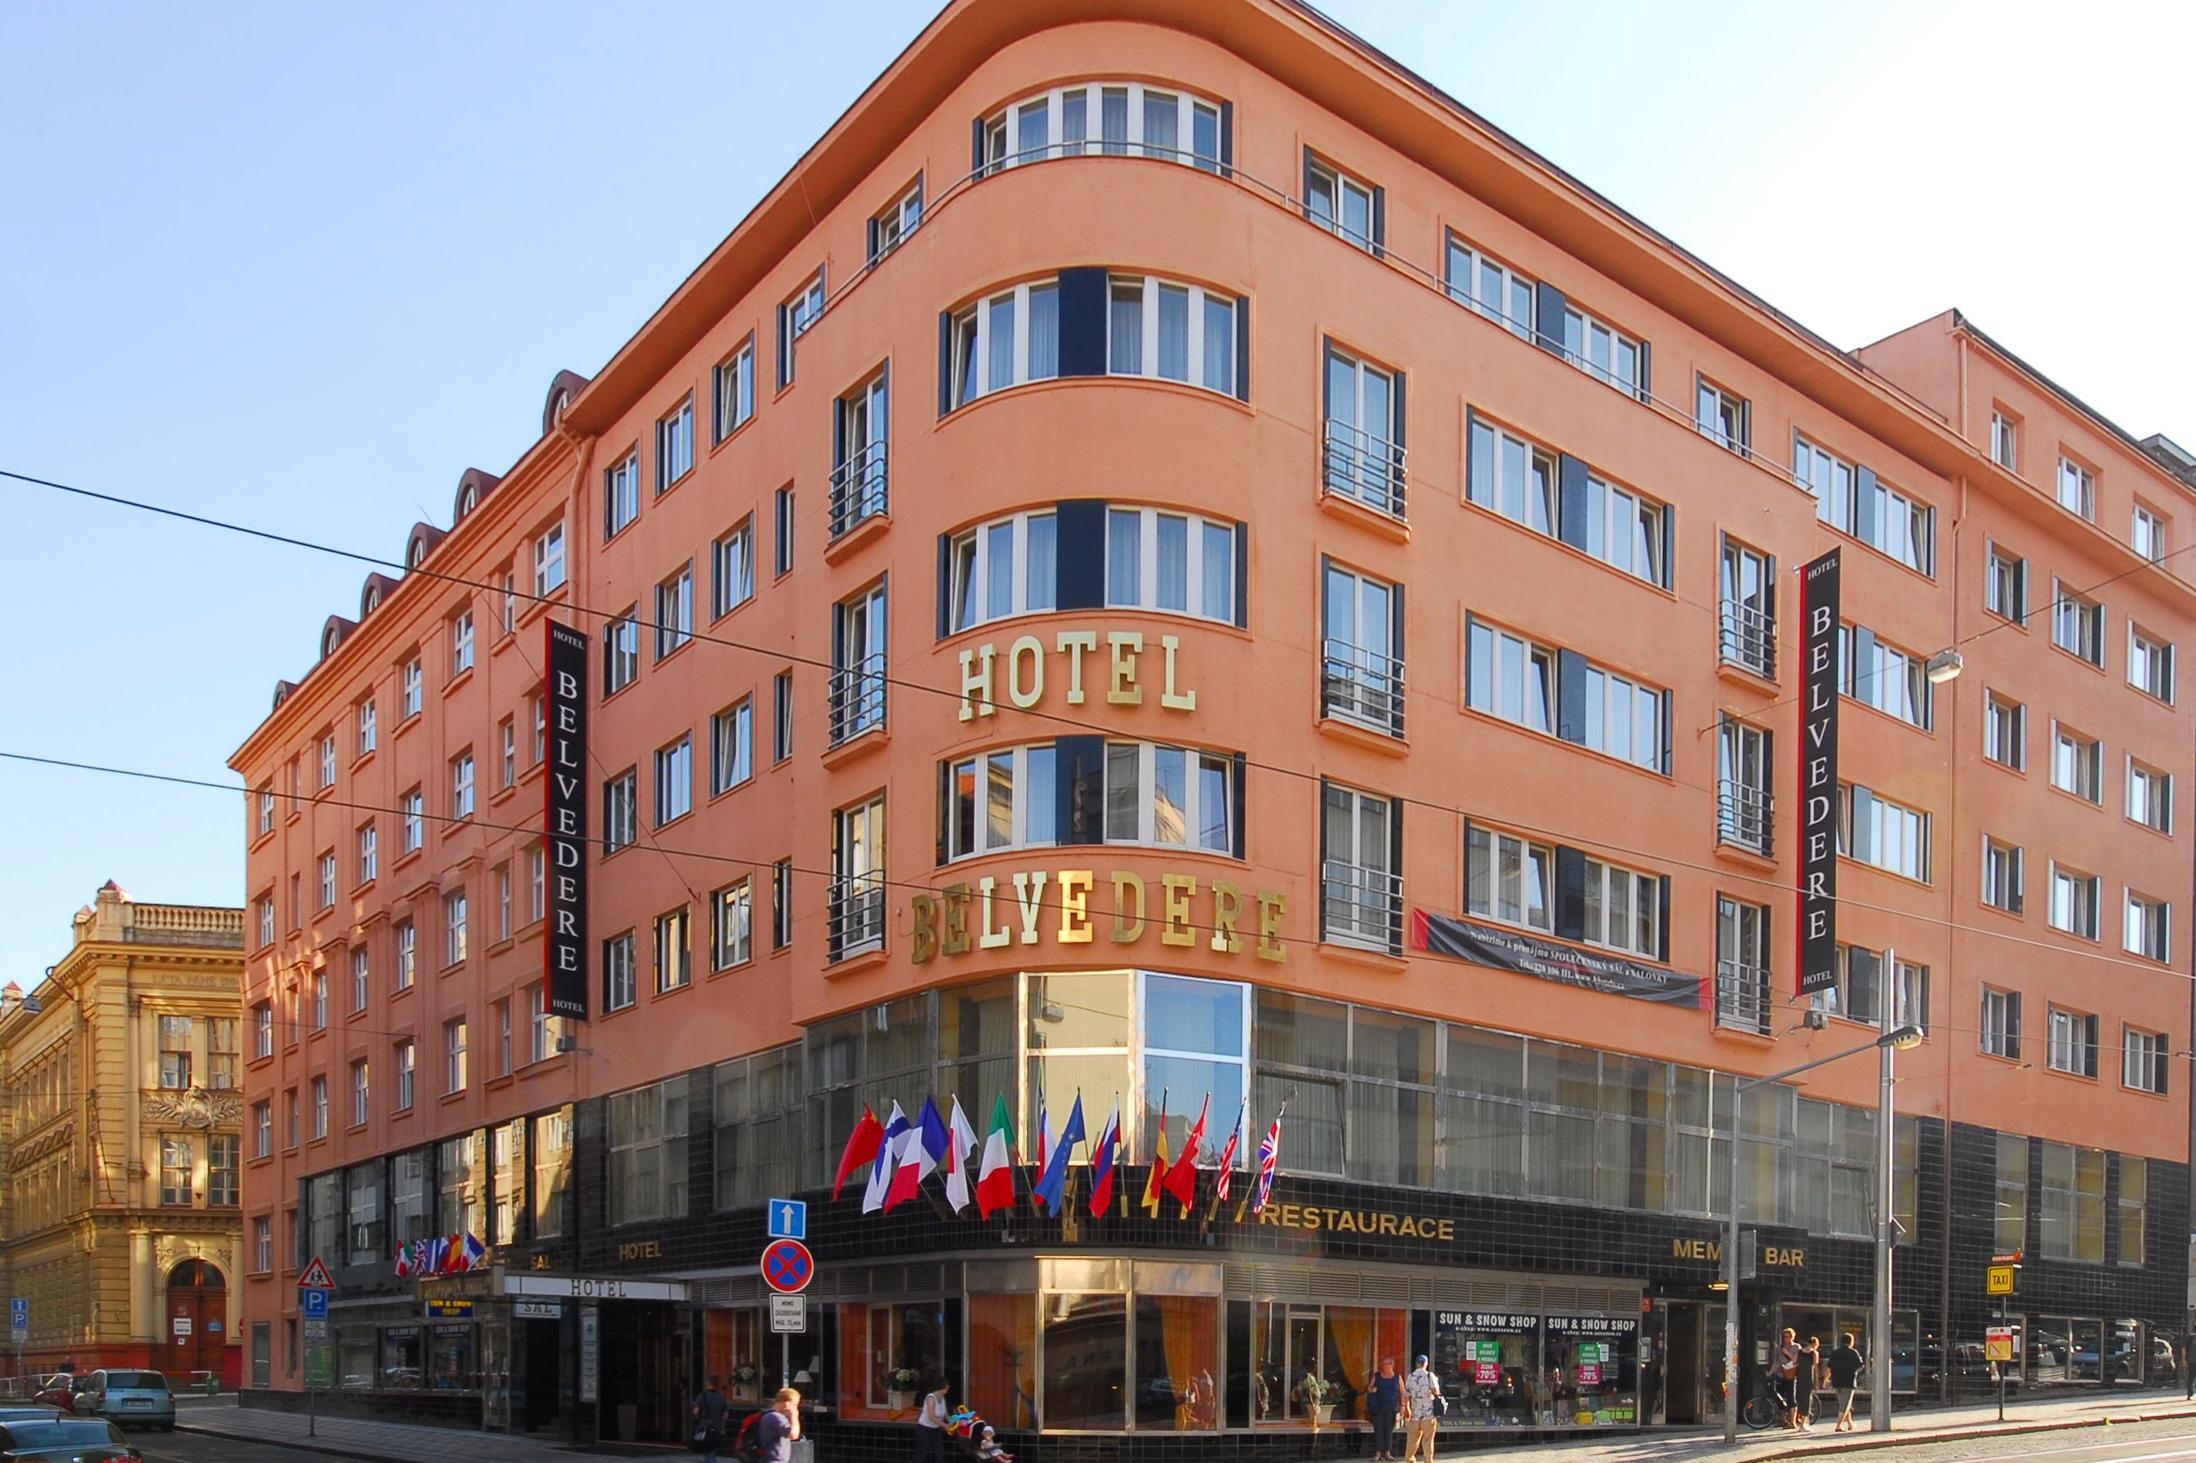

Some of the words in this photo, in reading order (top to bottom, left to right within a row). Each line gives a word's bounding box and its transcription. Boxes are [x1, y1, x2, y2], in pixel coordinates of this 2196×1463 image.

[1807, 558, 1838, 580] HOTEL
[553, 628, 585, 650] HOTEL
[958, 631, 1197, 722] HOTEL
[1807, 605, 1831, 940] BELVEDERE
[555, 669, 580, 971] BELVEDERE
[911, 870, 1287, 965] BELVEDERE
[1803, 970, 1833, 986] HOTEL
[552, 998, 585, 1013] HOTEL
[1259, 1204, 1455, 1241] RESTAURACE
[619, 1242, 663, 1260] HOTEL
[1673, 1238, 1722, 1261] MEM
[1765, 1247, 1804, 1267] BAR
[570, 1279, 627, 1298] HOTEL
[1992, 1275, 2009, 1285] TAXI
[309, 1292, 322, 1310] P
[15, 1313, 25, 1324] P
[1440, 1312, 1461, 1324] SUN
[1465, 1314, 1473, 1325] &
[1476, 1314, 1507, 1327] SNOW
[1509, 1316, 1537, 1328] SHOP
[1548, 1318, 1567, 1329] SUN
[1570, 1319, 1578, 1329] &
[1581, 1319, 1609, 1330] SNOW
[1610, 1320, 1636, 1331] SHOP
